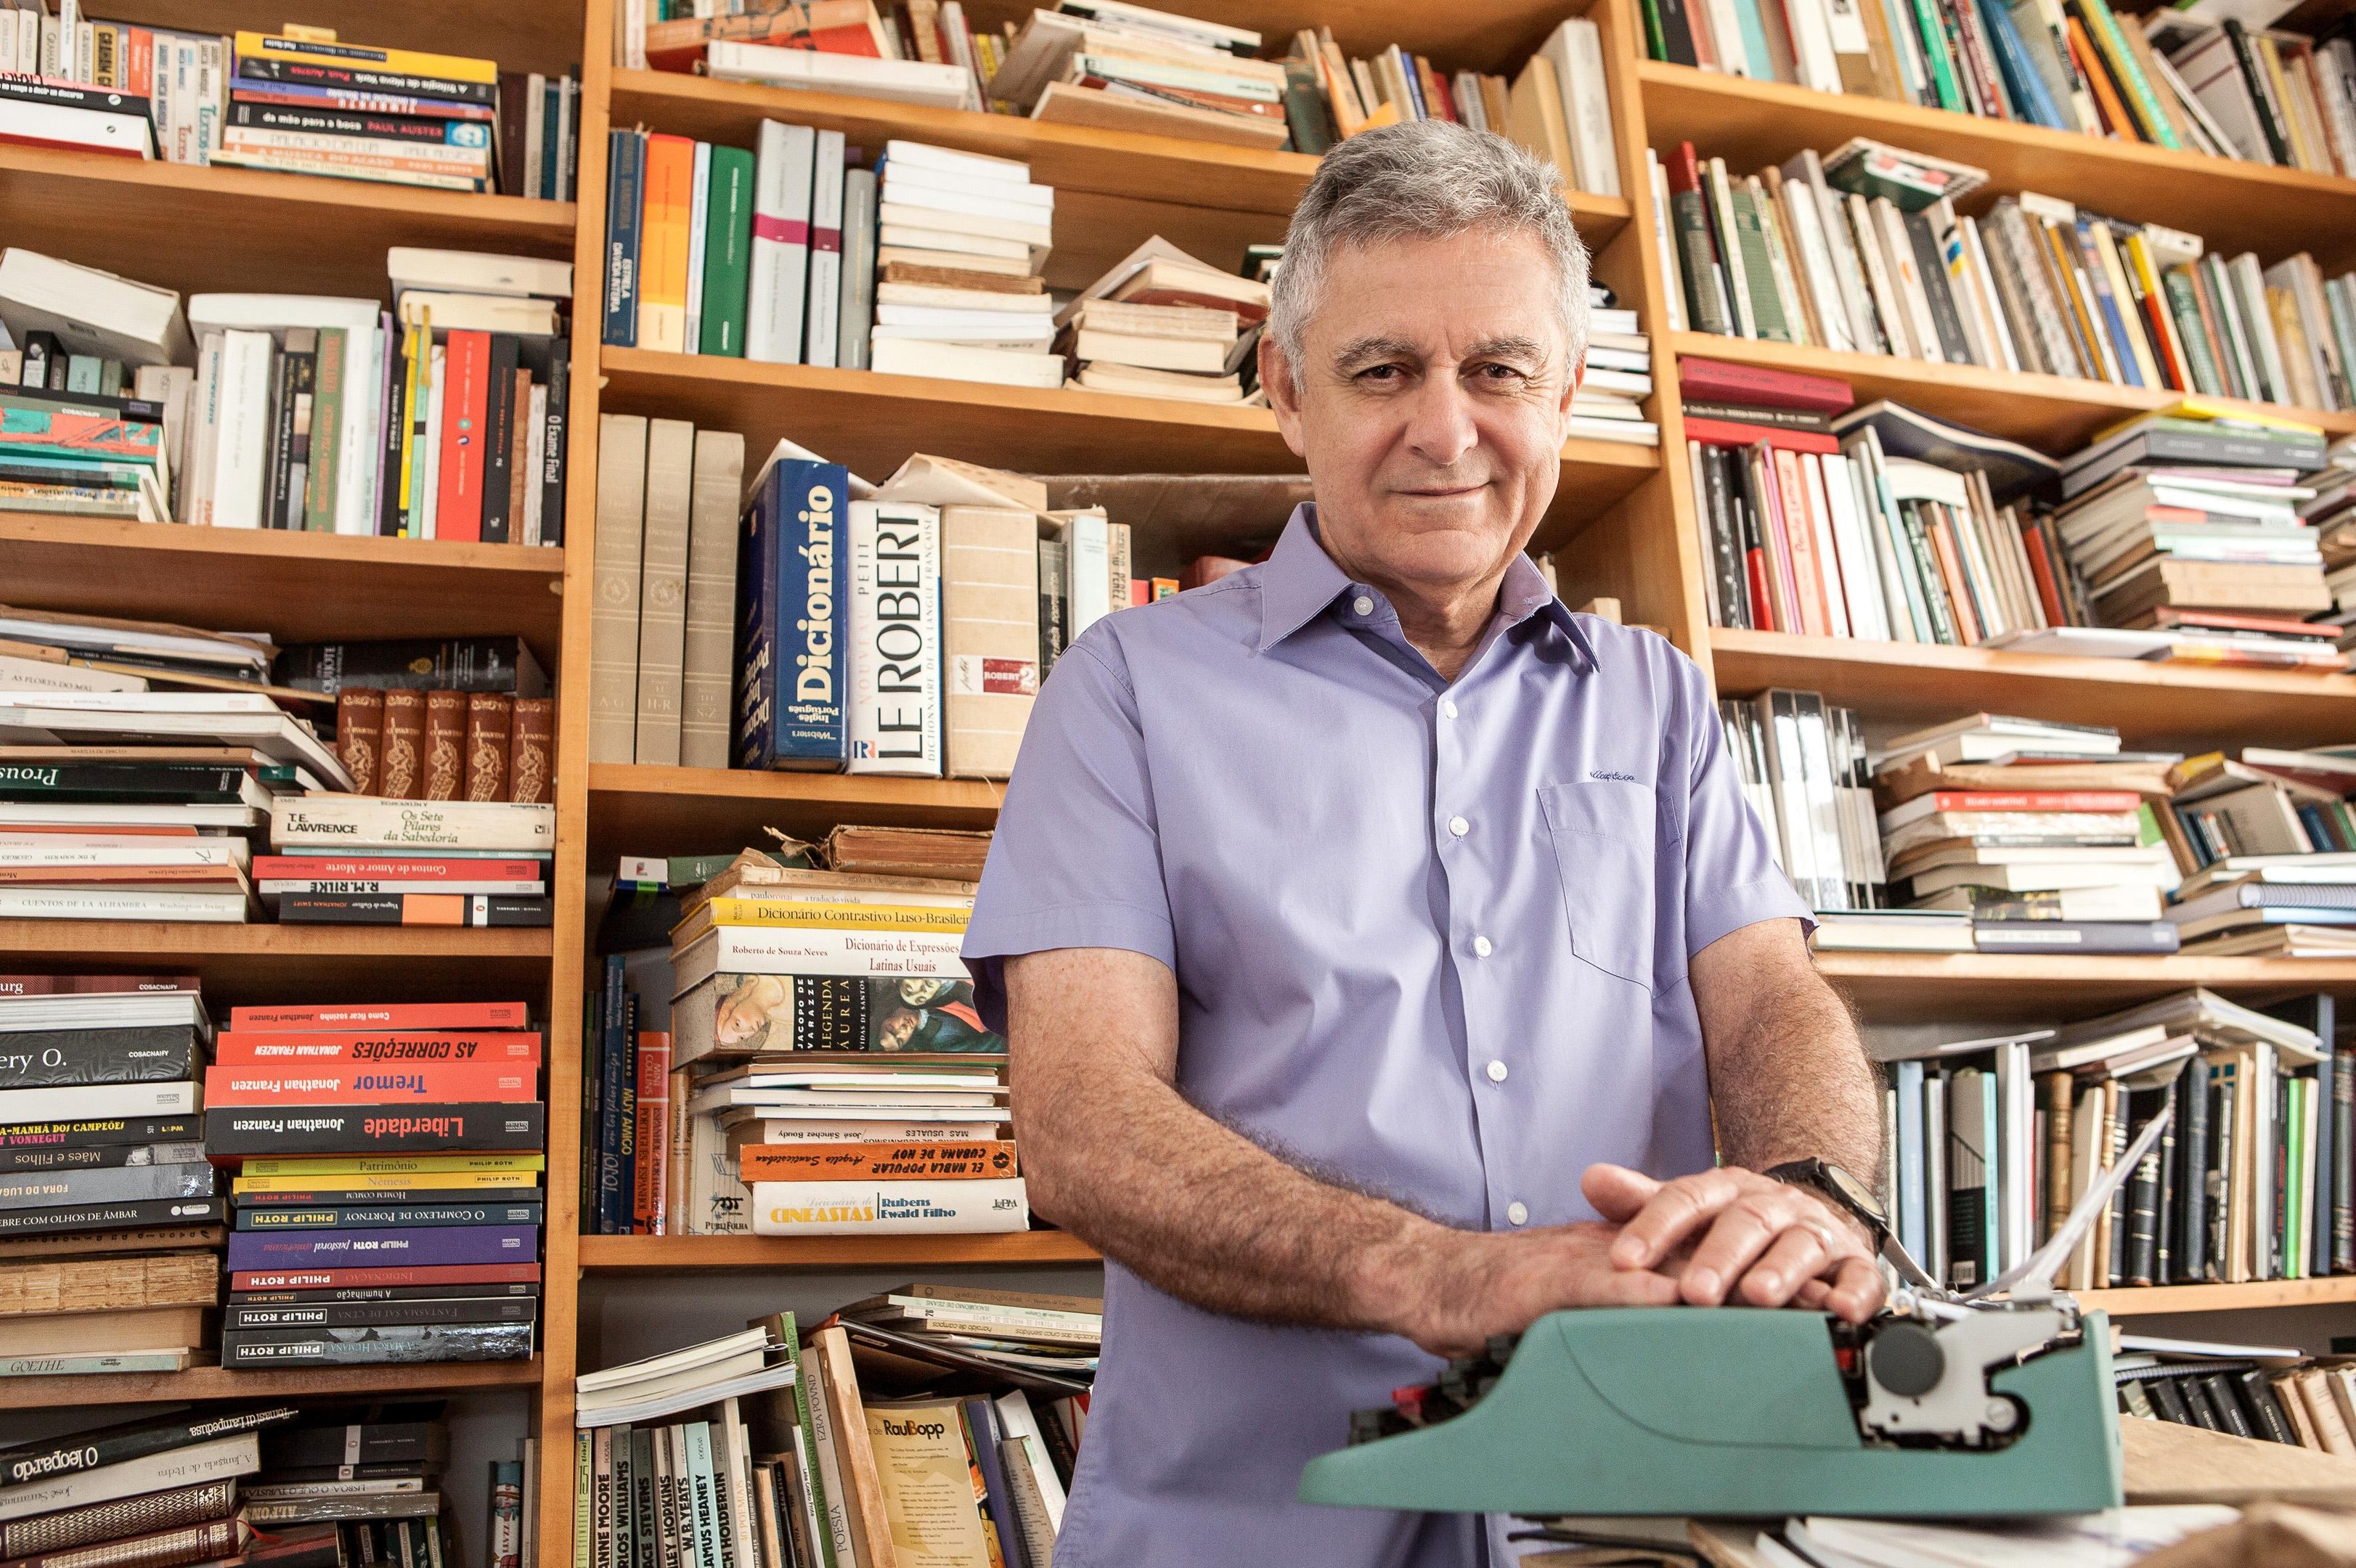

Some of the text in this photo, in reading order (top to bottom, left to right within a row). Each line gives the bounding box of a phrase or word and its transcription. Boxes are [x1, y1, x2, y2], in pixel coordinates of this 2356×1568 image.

[546, 425, 561, 457] Exame
[545, 458, 559, 483] Final
[857, 542, 869, 595] PETIT
[797, 484, 833, 703] Dicionário
[876, 507, 923, 759] LE ROBERT
[924, 518, 936, 761] DICTIONNAIRE DE LA LANGUE FRANÇAISE
[985, 666, 1035, 686] ROBERT 2
[788, 704, 839, 716] Português
[402, 810, 444, 822] Os Sete
[287, 822, 358, 834] LAWRENCE
[404, 821, 441, 832] Pilares
[383, 832, 458, 843] da Sabedoria
[325, 863, 356, 873] Morte
[366, 863, 396, 874] Amor
[397, 864, 409, 875] de
[411, 864, 447, 875] Contos
[97, 900, 147, 909] ALHAMBRA
[757, 905, 822, 922] Dicionário
[824, 909, 892, 924] Contrastivo
[732, 946, 763, 956] Roberto
[776, 947, 802, 957] Souza
[803, 947, 828, 957] Neves
[845, 936, 960, 955] Dicionário de Expressões
[869, 957, 937, 973] Latinas Usuais
[797, 979, 804, 993] DE
[319, 1013, 348, 1021] sozinho
[367, 1012, 389, 1021] Como
[821, 980, 831, 1048] LEGENDA
[837, 981, 849, 1049] ÁUREA
[860, 1014, 865, 1023] DE
[255, 1045, 342, 1056] JONATHAN FRANZEN
[351, 1038, 477, 1060] AS CORREÇÕES
[42, 1048, 67, 1067] O.
[644, 1054, 654, 1095] COLLINS
[231, 1078, 341, 1093] Jonathan Franzen
[353, 1074, 426, 1095] Tremor
[73, 1122, 125, 1132] CAMPEÕES
[233, 1117, 345, 1133] Jonathan Franzen
[364, 1116, 464, 1138] Liberdade
[621, 1087, 634, 1156] MUY AMIGO
[9, 1133, 66, 1144] VONNEGUT
[778, 1130, 804, 1139] Boudy
[806, 1131, 840, 1140] Sánchez
[15, 1153, 52, 1164] Filhos
[68, 1152, 100, 1161] Mães
[892, 1148, 986, 1159] CUBANA DE HOY
[359, 1161, 417, 1172] Patrimônio
[754, 1154, 865, 1167] Argelio Santiesteban
[872, 1162, 985, 1175] EL HABLA POPULAR
[346, 1191, 406, 1201] HOMEM COMUM
[637, 1167, 647, 1212] ESPANHOL
[881, 1197, 931, 1207] Rubens
[23, 1207, 412, 1226] COM OLHOS DE ÂMBAR
[255, 1212, 334, 1225] PHILIP ROTH
[345, 1211, 395, 1222] PORTNOY
[475, 1210, 484, 1220] O
[770, 1206, 874, 1224] CINEASTAS
[881, 1207, 957, 1218] Ewald Filho
[314, 1239, 351, 1253] pastoral
[353, 1241, 378, 1250] ROTH
[380, 1241, 409, 1250] PHILIP
[251, 1275, 330, 1287] PHILIP ROTH
[247, 1294, 268, 1302] ROTH
[336, 1289, 383, 1300] humilhação
[244, 1310, 323, 1323] PHILIP ROTH
[240, 1344, 320, 1357] PHILIP ROTH
[11, 1360, 65, 1373] GOETHE
[12, 1447, 99, 1481] O leopardo
[598, 1474, 611, 1527] MOORE
[616, 1460, 629, 1529] WILLIAMS
[696, 1474, 711, 1527] HEANEY
[638, 1477, 652, 1537] STEVENS
[659, 1474, 675, 1538] HOPKINS
[830, 1505, 847, 1553] POESIA
